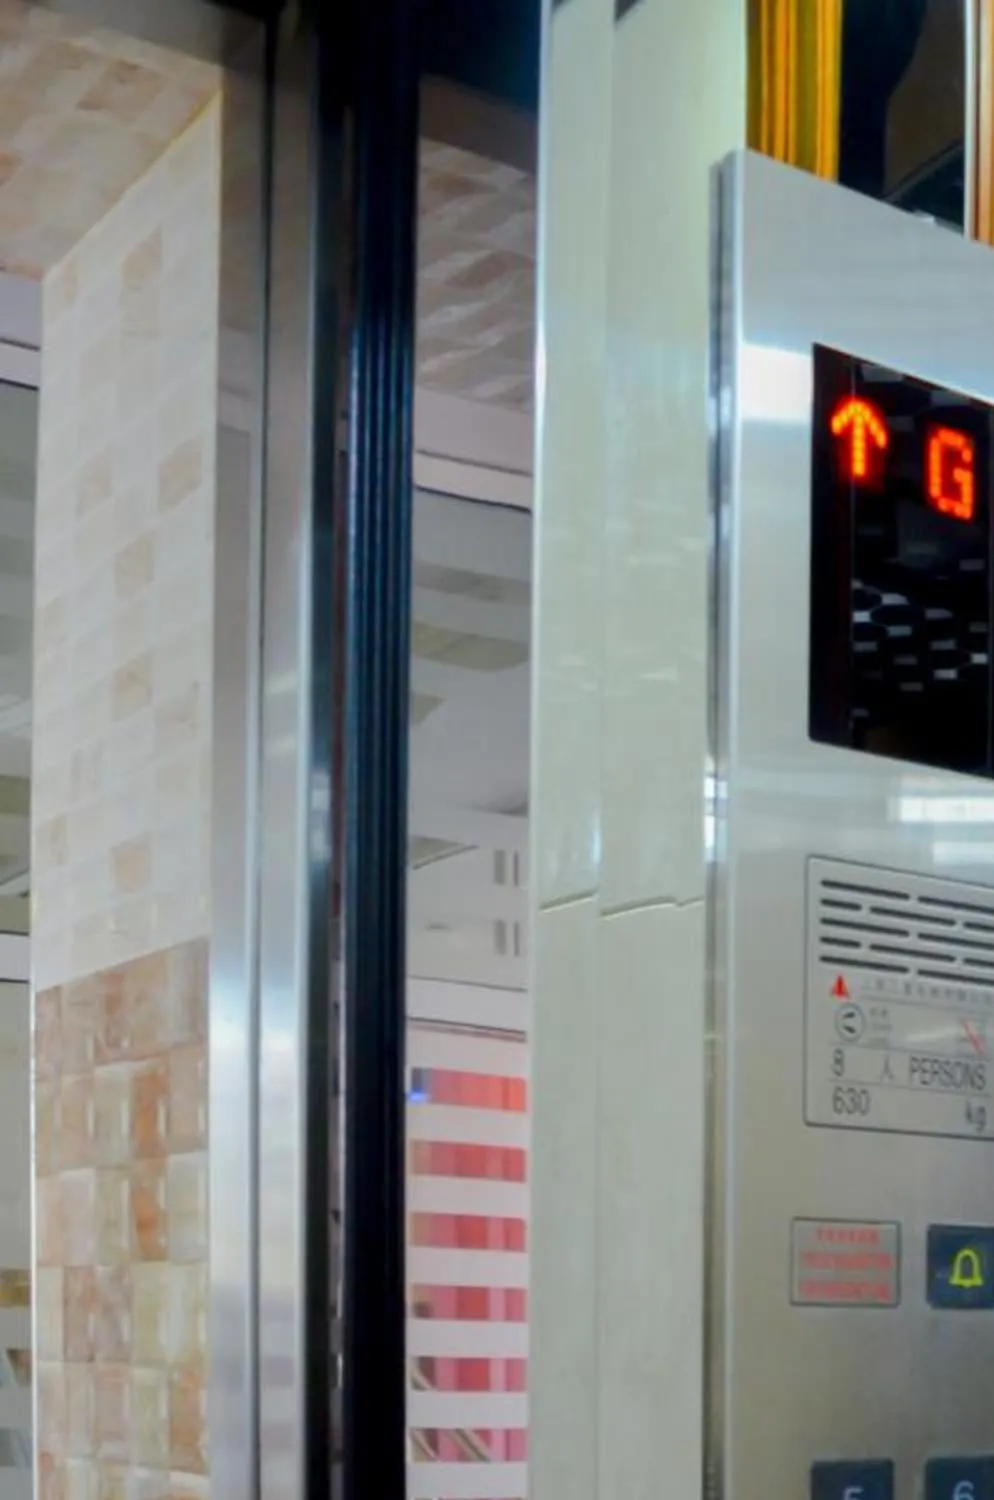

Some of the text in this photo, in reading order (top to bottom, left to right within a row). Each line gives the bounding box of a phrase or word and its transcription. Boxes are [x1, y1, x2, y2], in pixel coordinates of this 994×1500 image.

[927, 425, 975, 522] G
[832, 1048, 845, 1078] 8
[910, 1056, 986, 1092] PERSONS
[832, 1086, 872, 1117] 630
